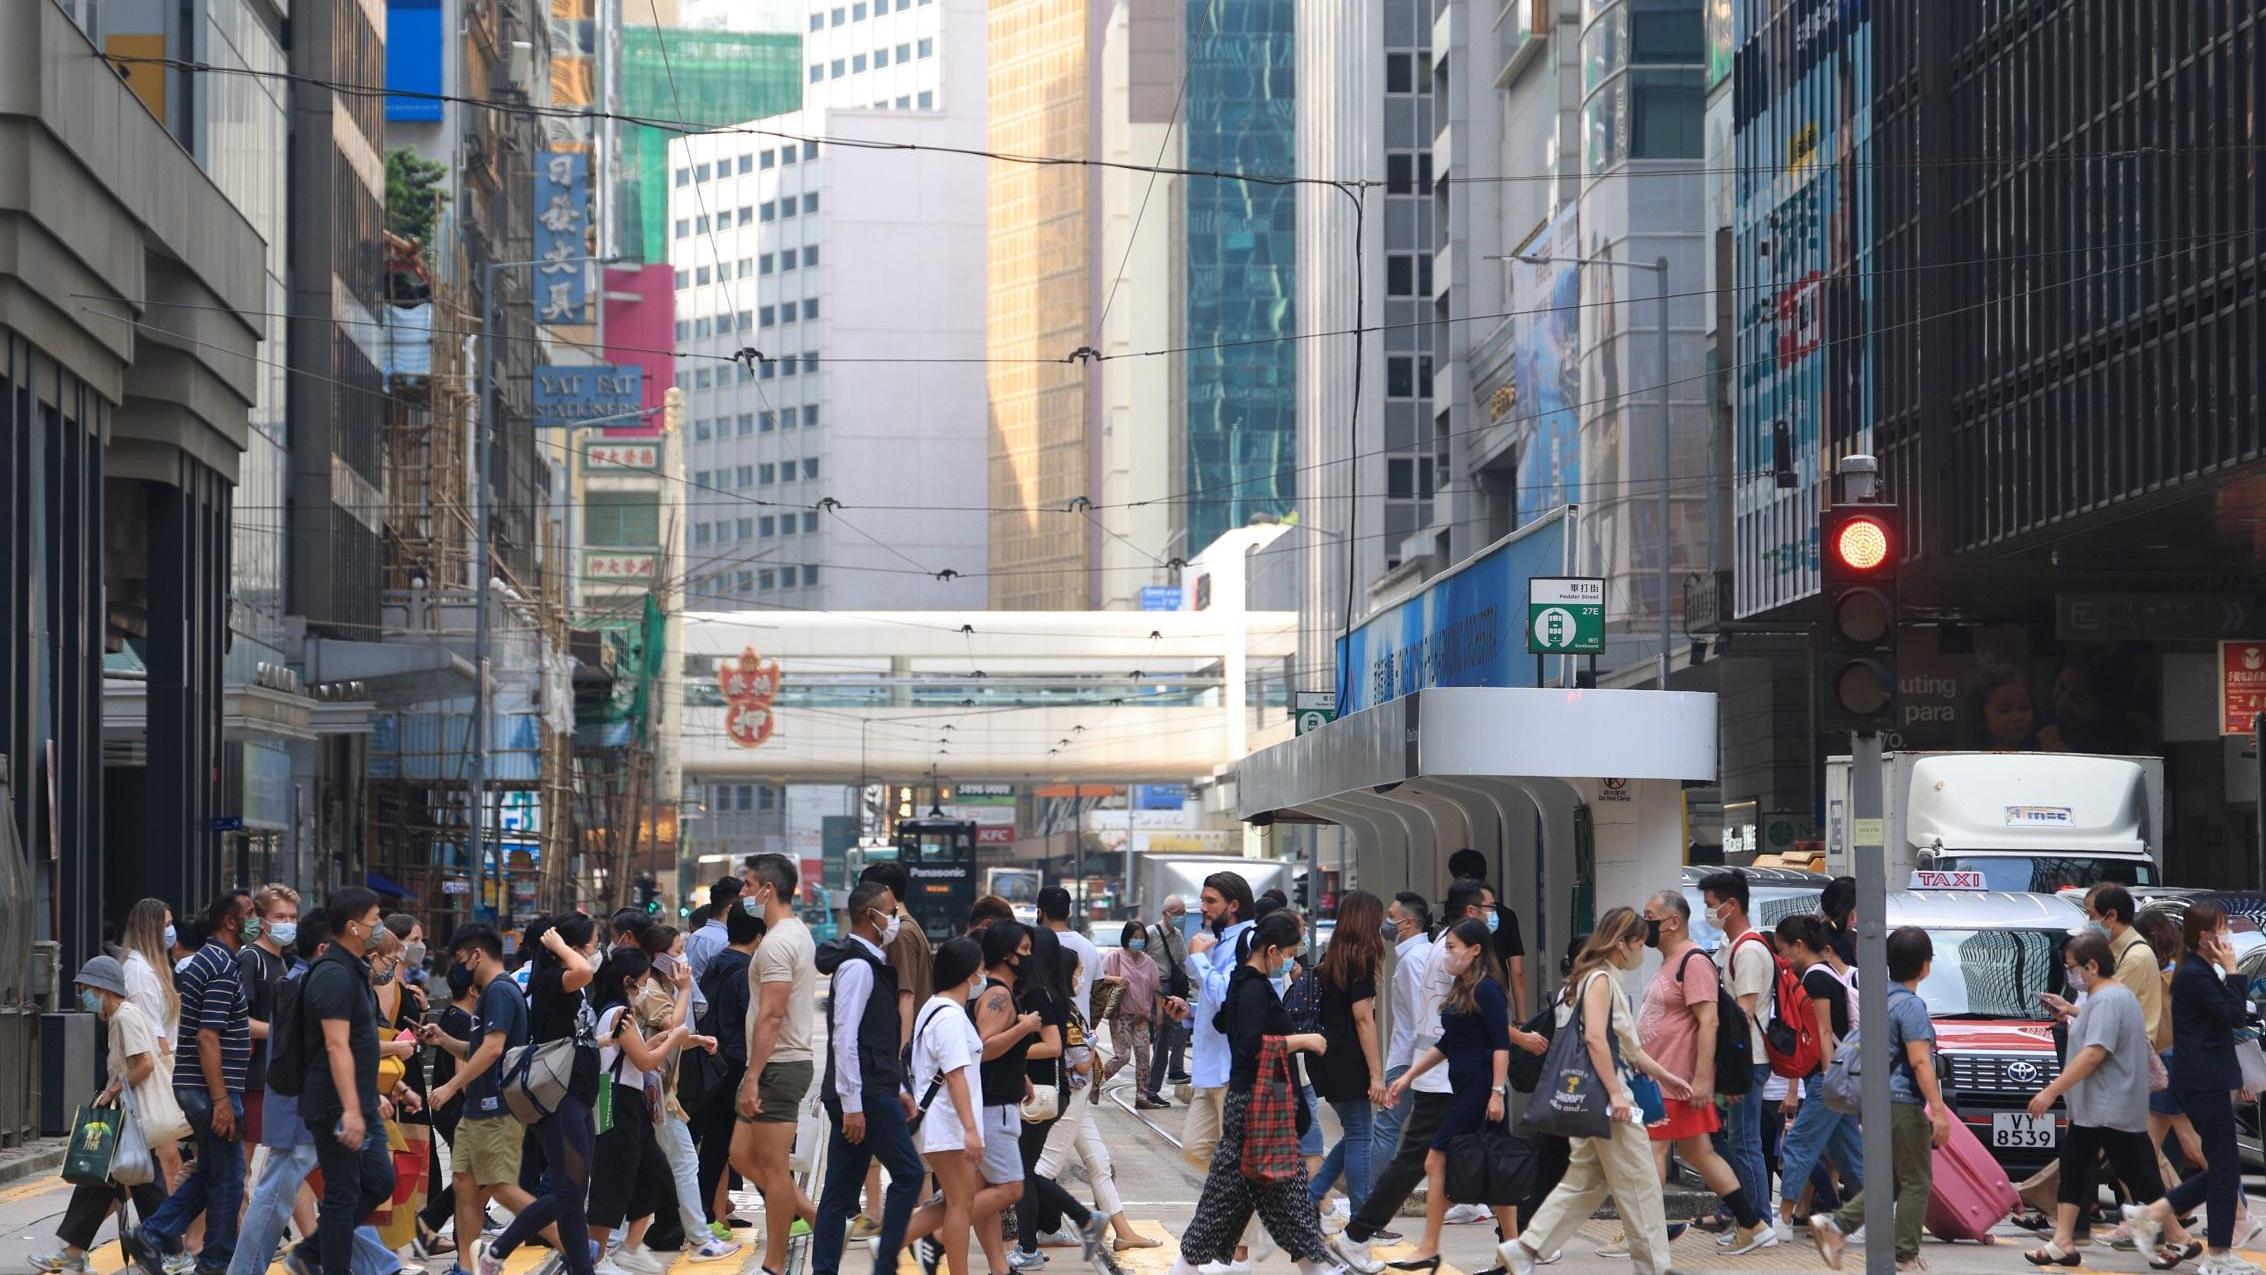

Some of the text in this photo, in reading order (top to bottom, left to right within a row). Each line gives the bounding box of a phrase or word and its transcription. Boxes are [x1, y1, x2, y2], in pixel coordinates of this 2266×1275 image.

[540, 375, 583, 395] YAT
[1582, 607, 1600, 616] 27E
[1904, 705, 1955, 726] para
[979, 830, 1008, 841] KFC
[910, 867, 966, 878] Panasonic
[1918, 872, 1980, 888] TAXI
[1554, 1089, 1586, 1104] SNOOPY
[1997, 1130, 2051, 1147] 8539
